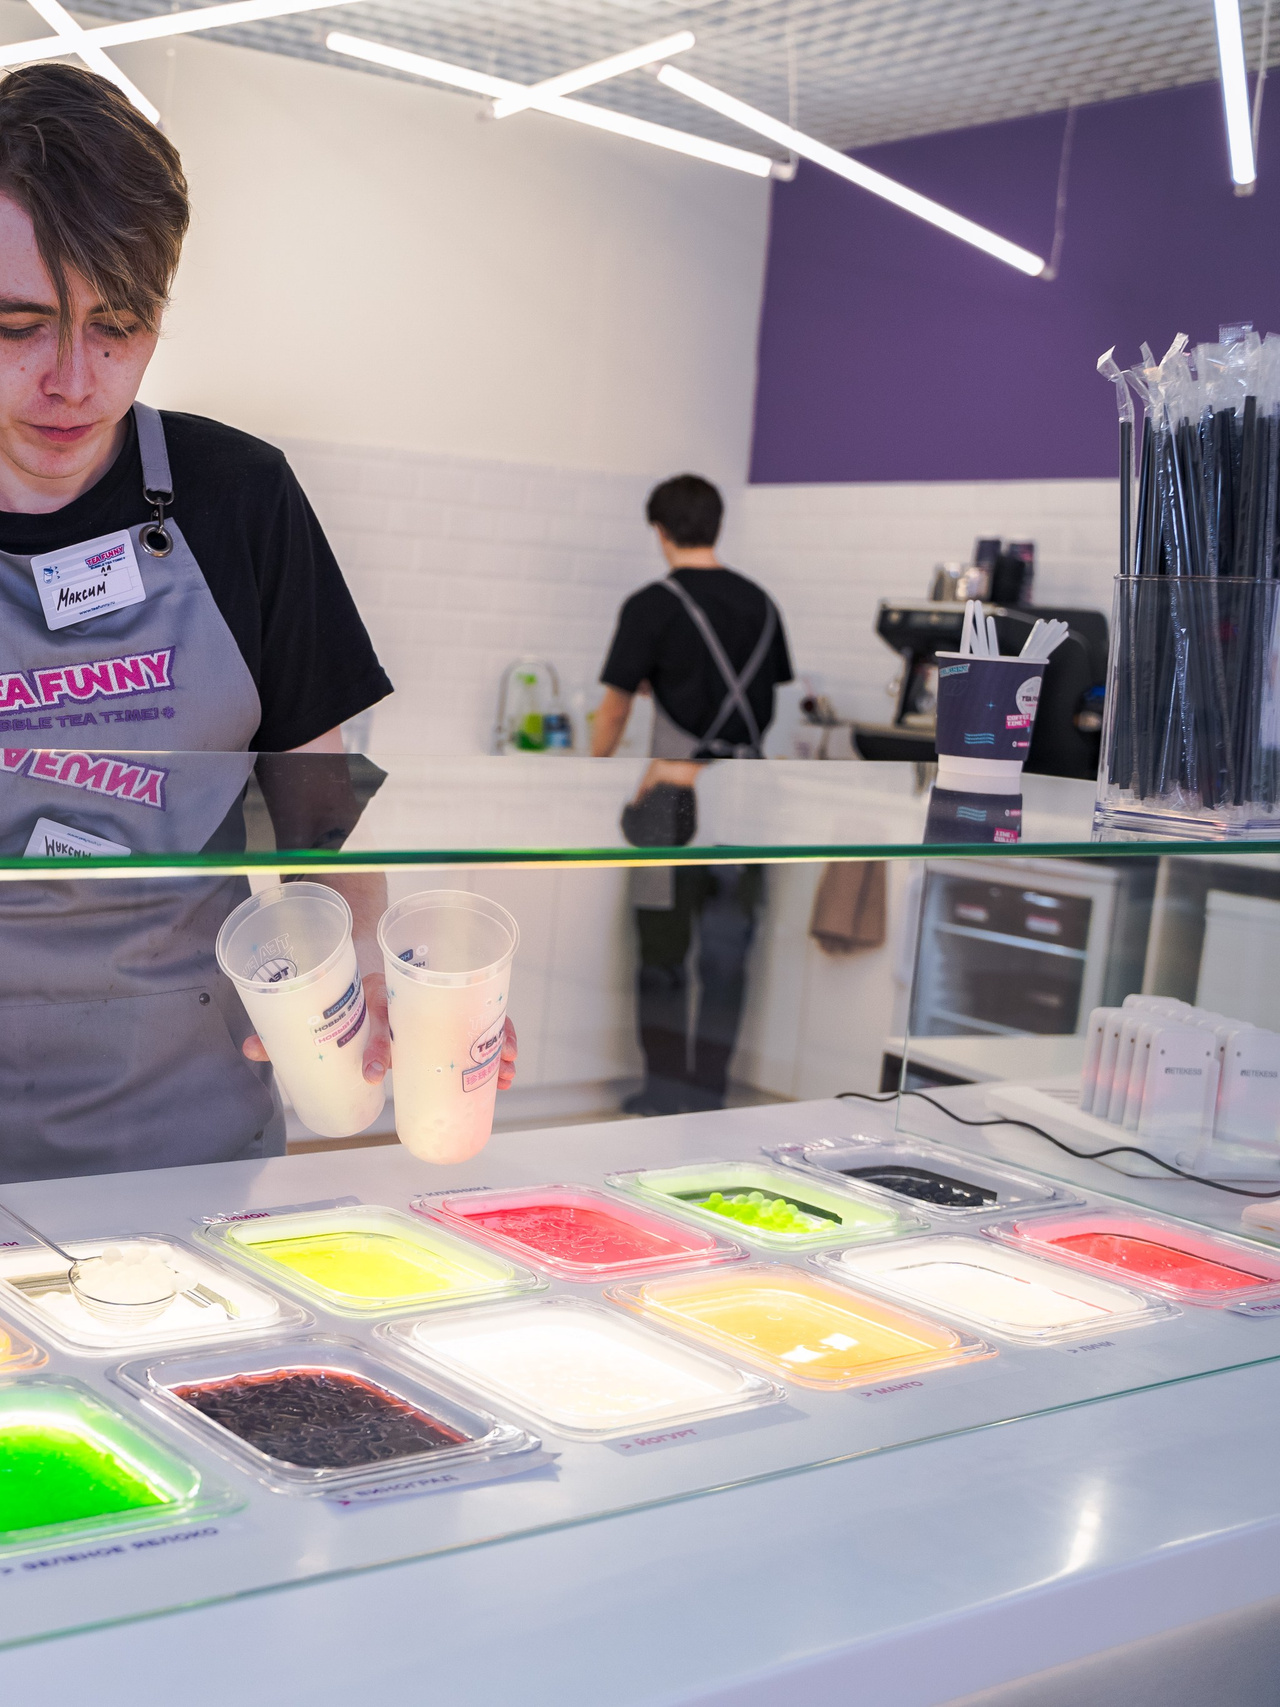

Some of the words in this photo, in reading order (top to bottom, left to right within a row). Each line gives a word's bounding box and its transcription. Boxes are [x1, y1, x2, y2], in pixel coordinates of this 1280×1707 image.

[85, 554, 101, 568] TEA
[100, 544, 125, 561] FUNNY
[35, 651, 170, 706] FUNNY
[55, 712, 97, 728] TEA
[99, 708, 159, 724] TIME!
[477, 1035, 497, 1053] TEA
[873, 1381, 924, 1395] МАНГО
[633, 1428, 697, 1446] ЙОГУРТ
